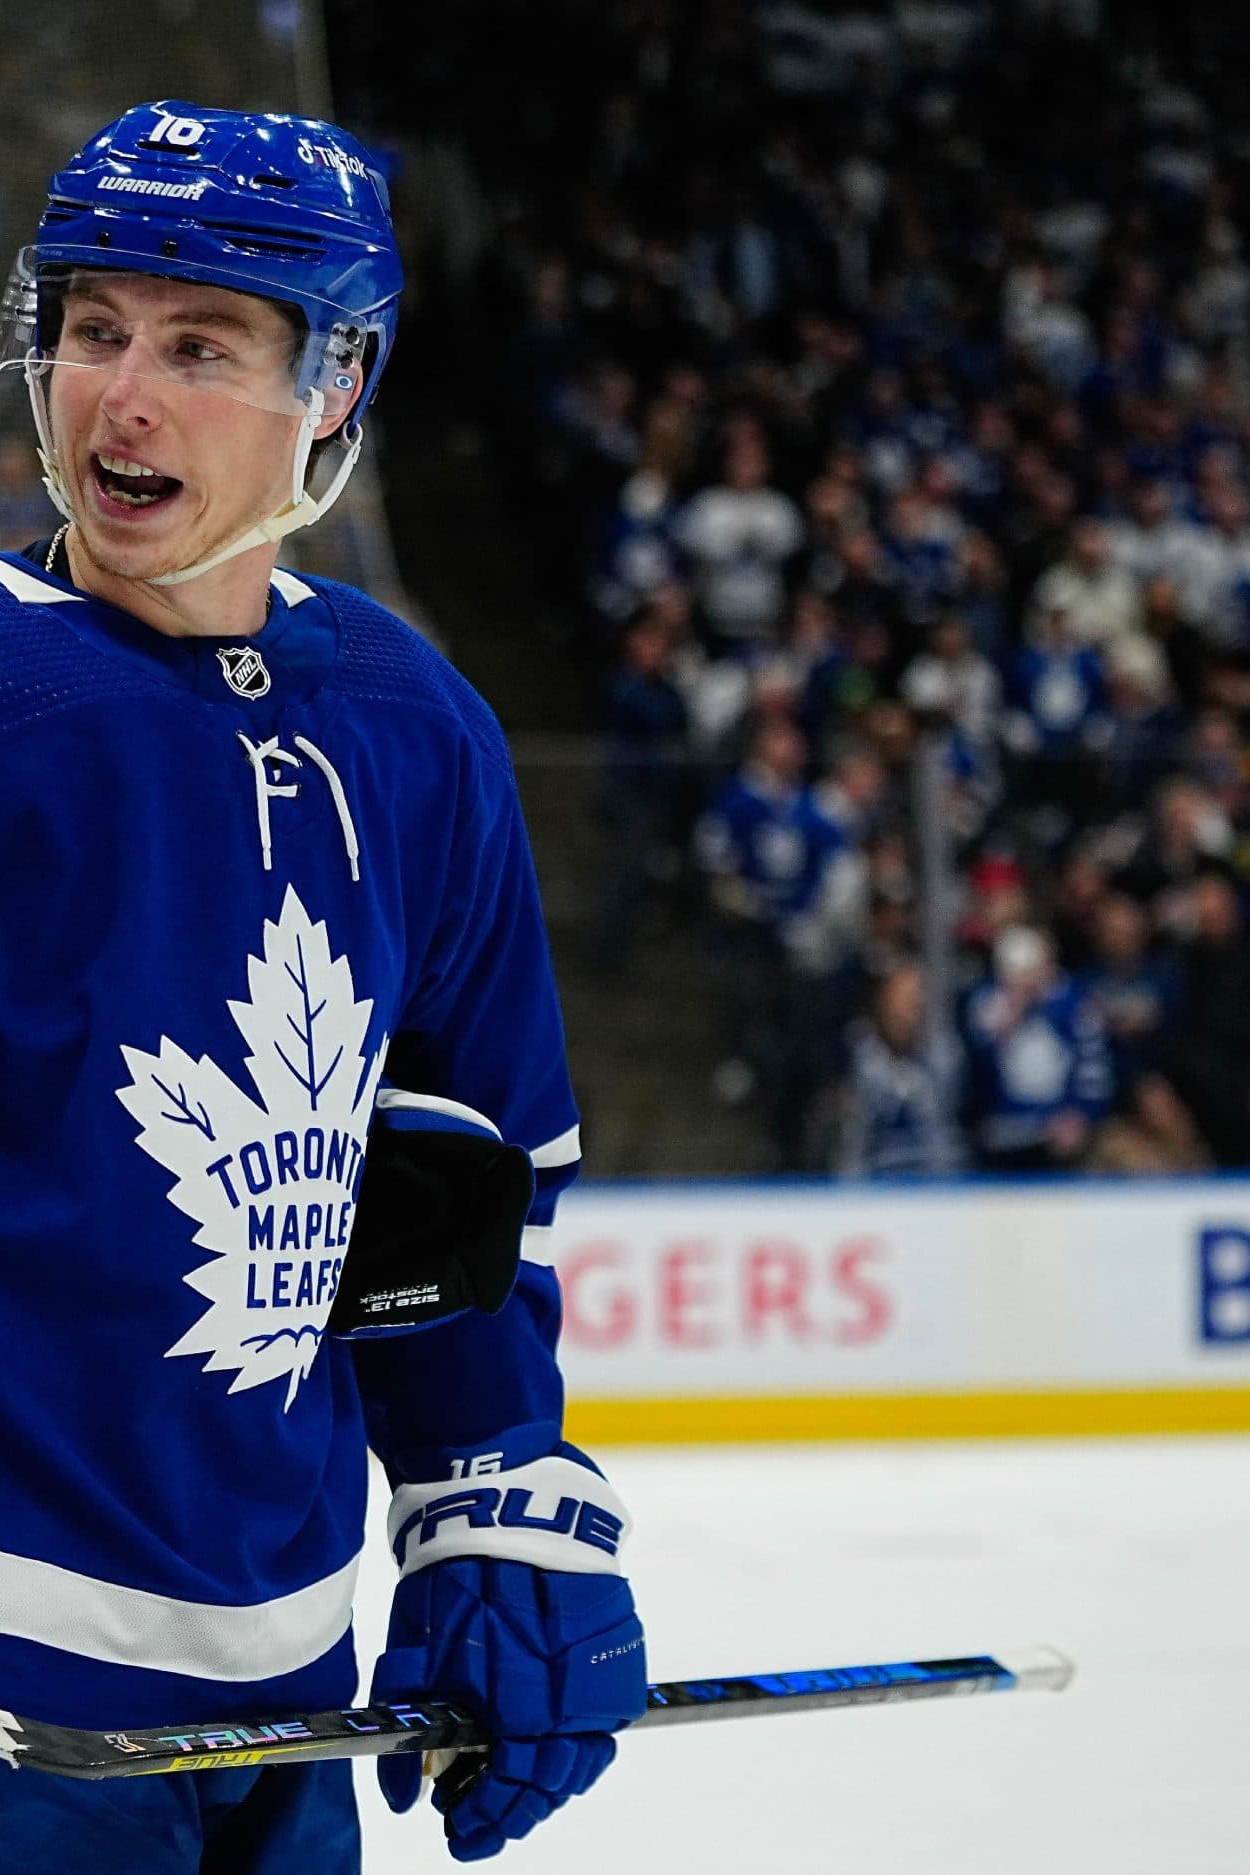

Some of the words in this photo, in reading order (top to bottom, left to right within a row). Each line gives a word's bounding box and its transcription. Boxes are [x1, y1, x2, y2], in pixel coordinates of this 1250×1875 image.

[148, 114, 206, 146] 16
[97, 176, 206, 201] WARRIOR
[235, 658, 257, 686] NHL
[248, 1201, 352, 1251] MAPLE
[246, 1258, 343, 1309] LEAFS
[393, 1487, 625, 1570] TRUE
[157, 1721, 314, 1752] TRUE
